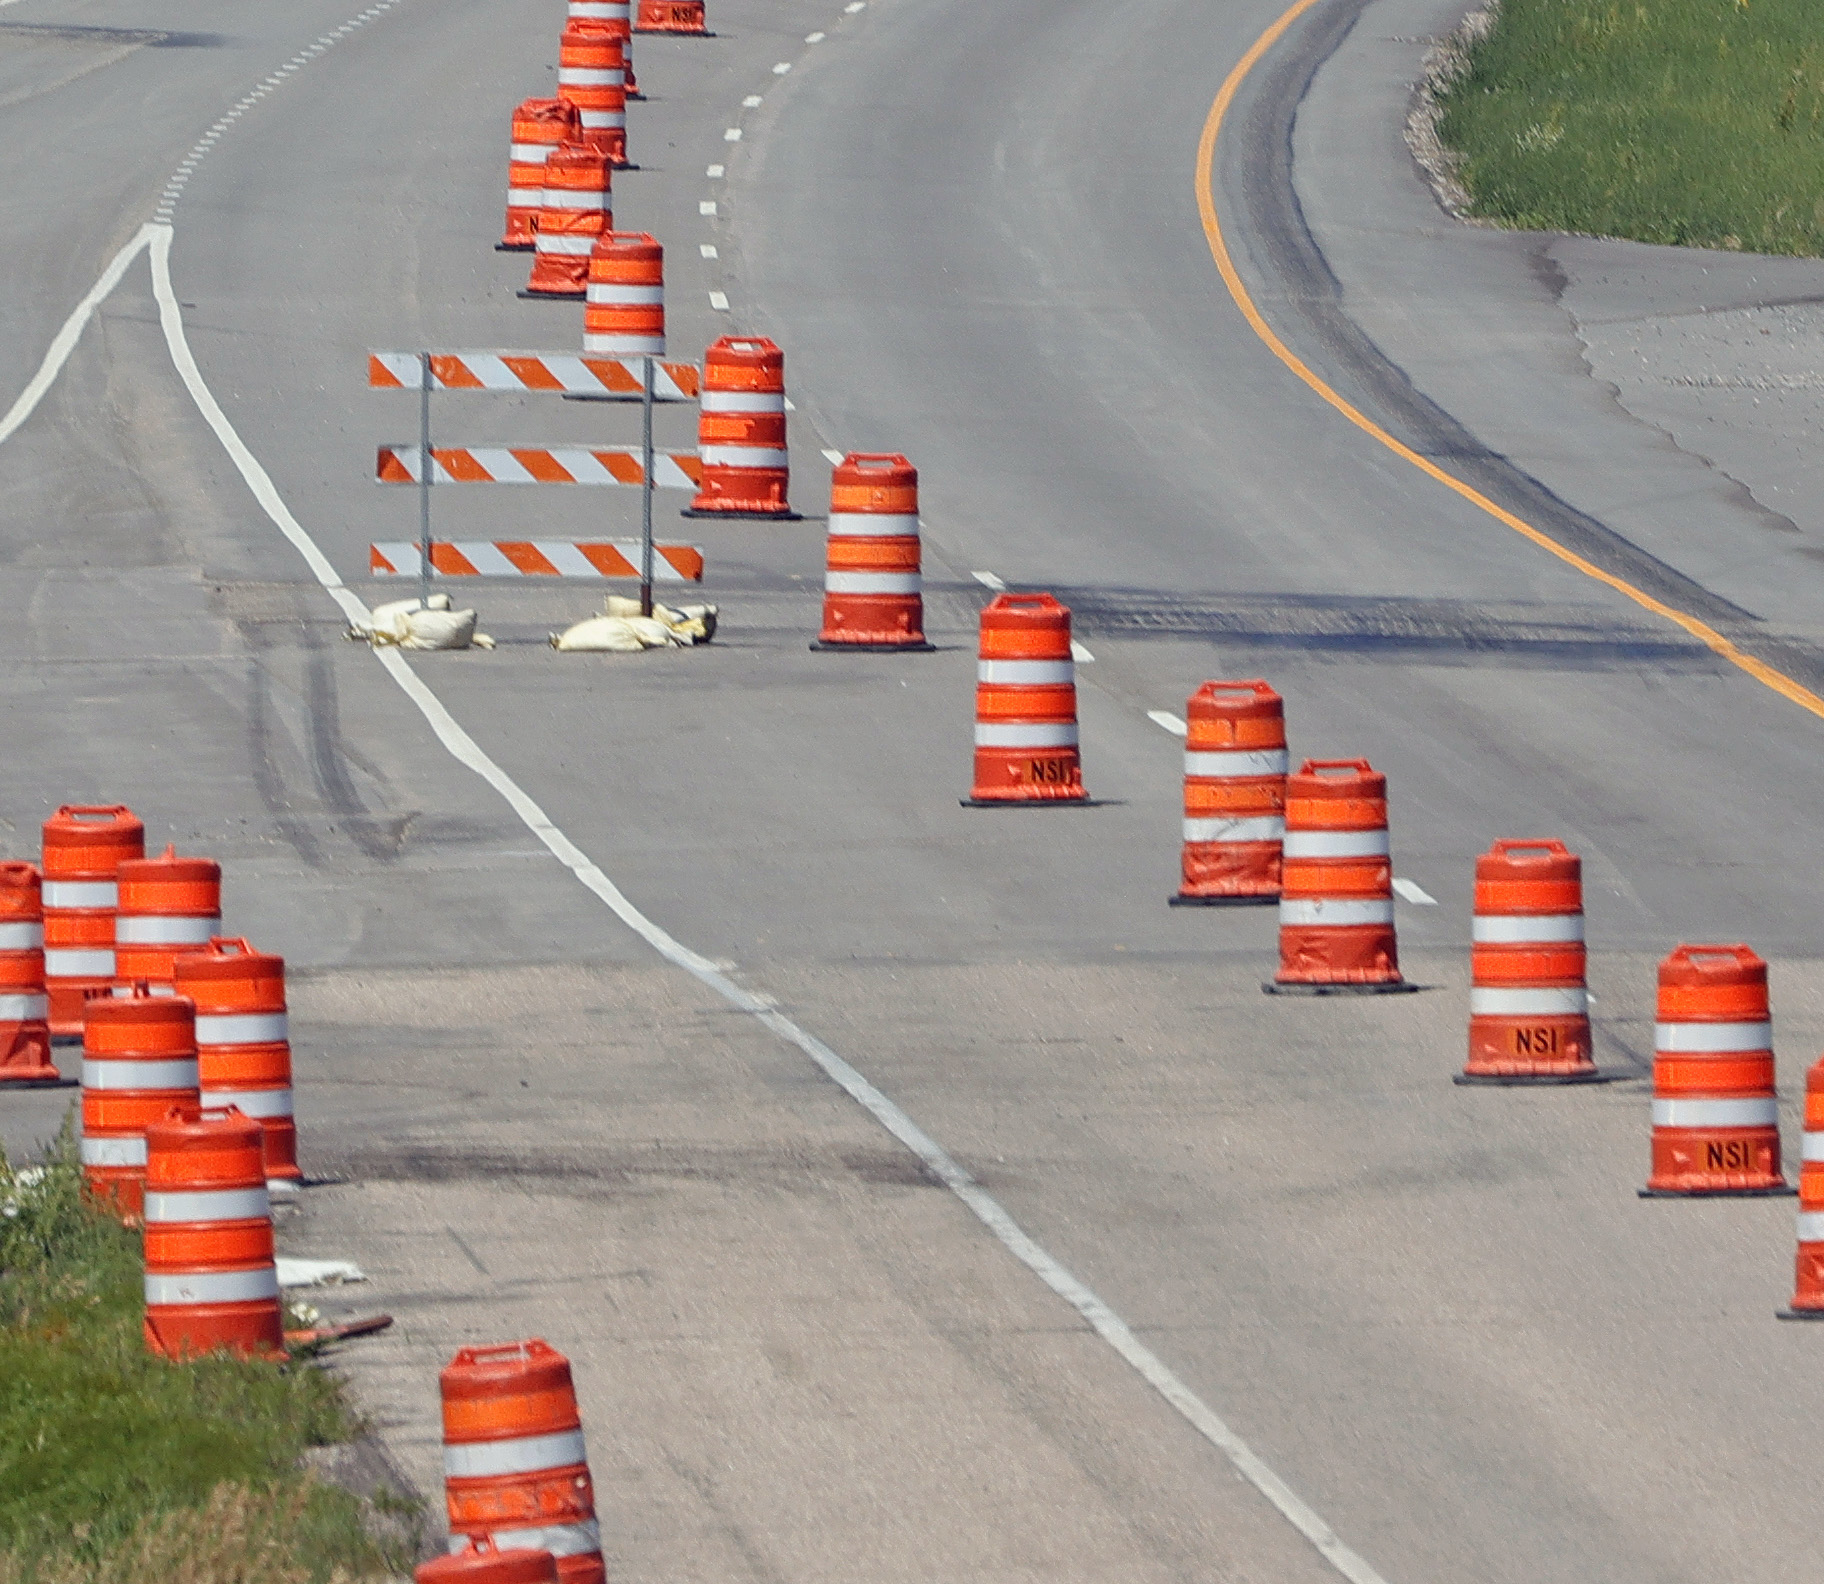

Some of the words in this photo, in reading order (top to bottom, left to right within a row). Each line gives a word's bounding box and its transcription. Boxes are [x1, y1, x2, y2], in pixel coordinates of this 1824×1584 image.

[1031, 758, 1064, 783] NSI
[1516, 1027, 1557, 1054] NSI
[1707, 1141, 1750, 1169] NSI
